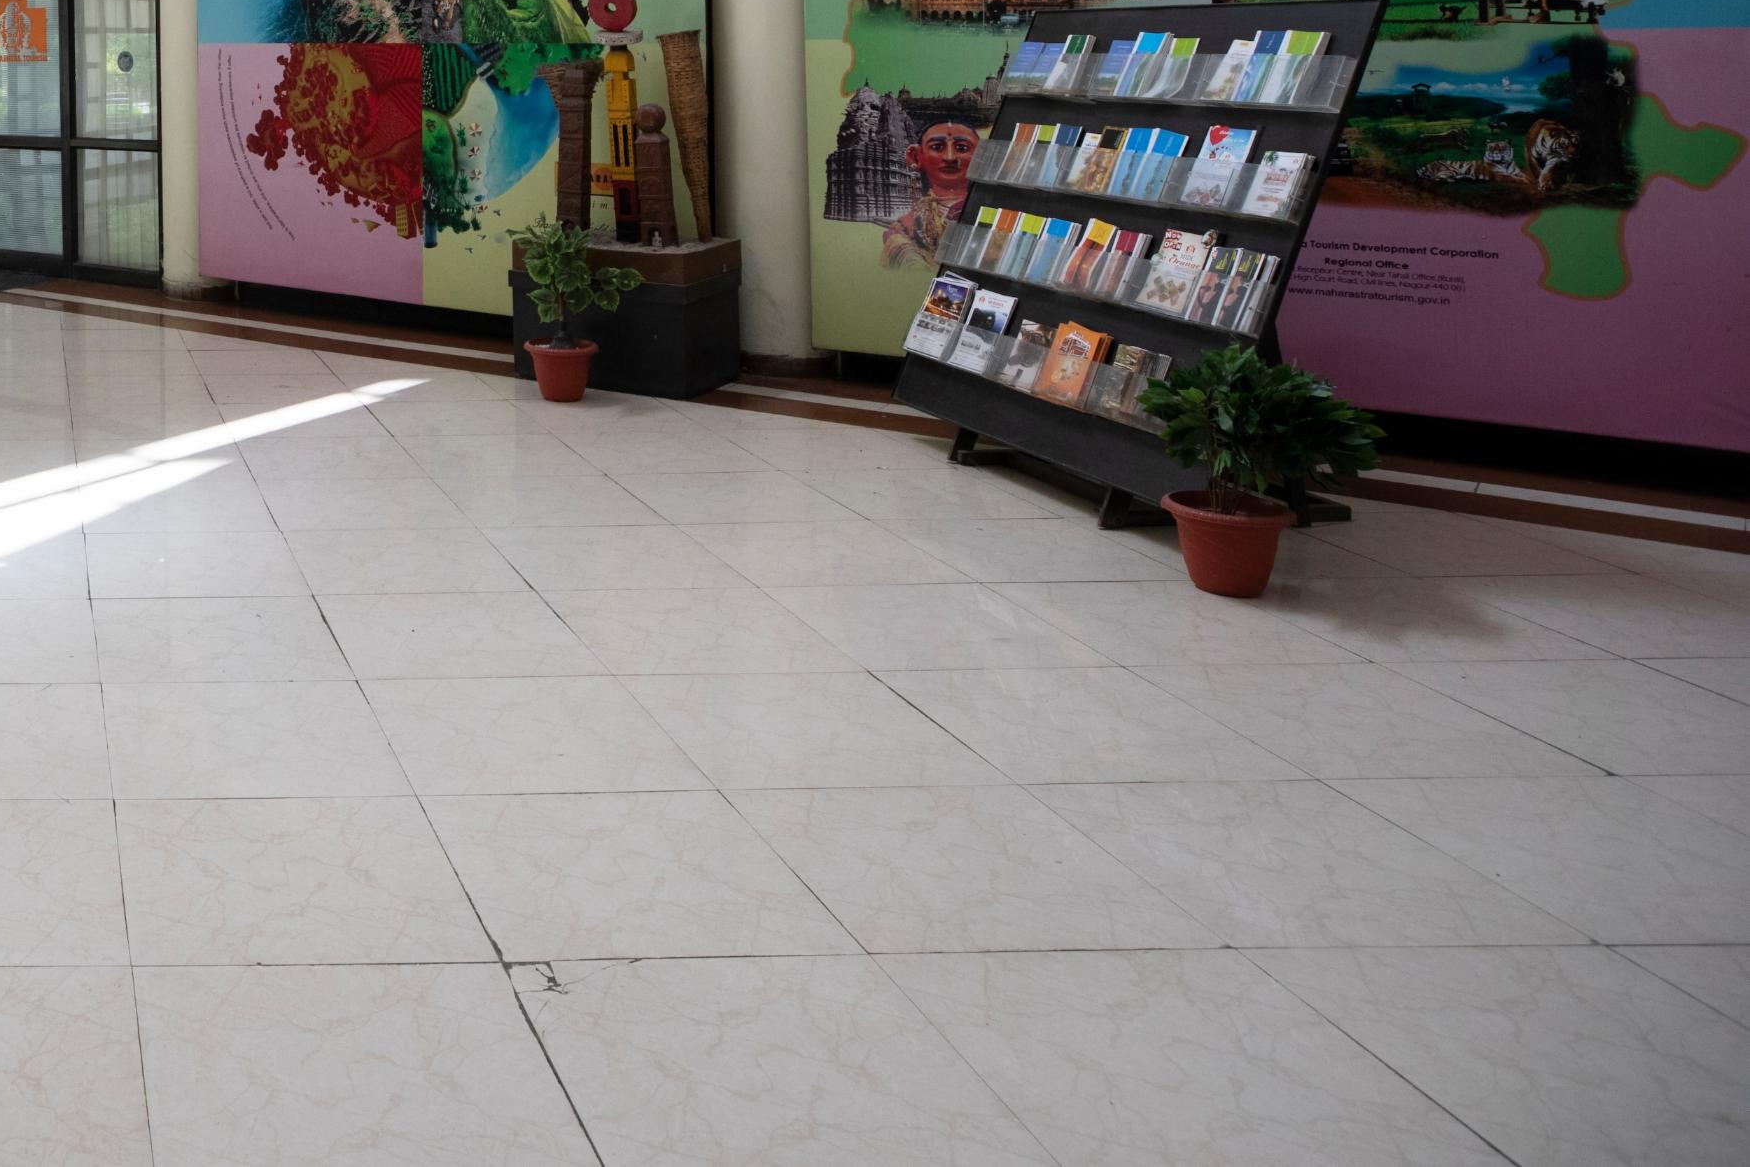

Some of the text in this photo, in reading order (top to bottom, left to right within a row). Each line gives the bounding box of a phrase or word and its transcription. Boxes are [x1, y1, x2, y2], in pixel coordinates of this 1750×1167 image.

[1310, 240, 1349, 251] Tourism
[1353, 242, 1427, 255] Development
[1430, 247, 1499, 259] Corporation
[1324, 257, 1409, 269] Regional Office
[1293, 274, 1312, 282] High
[1314, 275, 1335, 283] Court
[1411, 273, 1435, 281] Office
